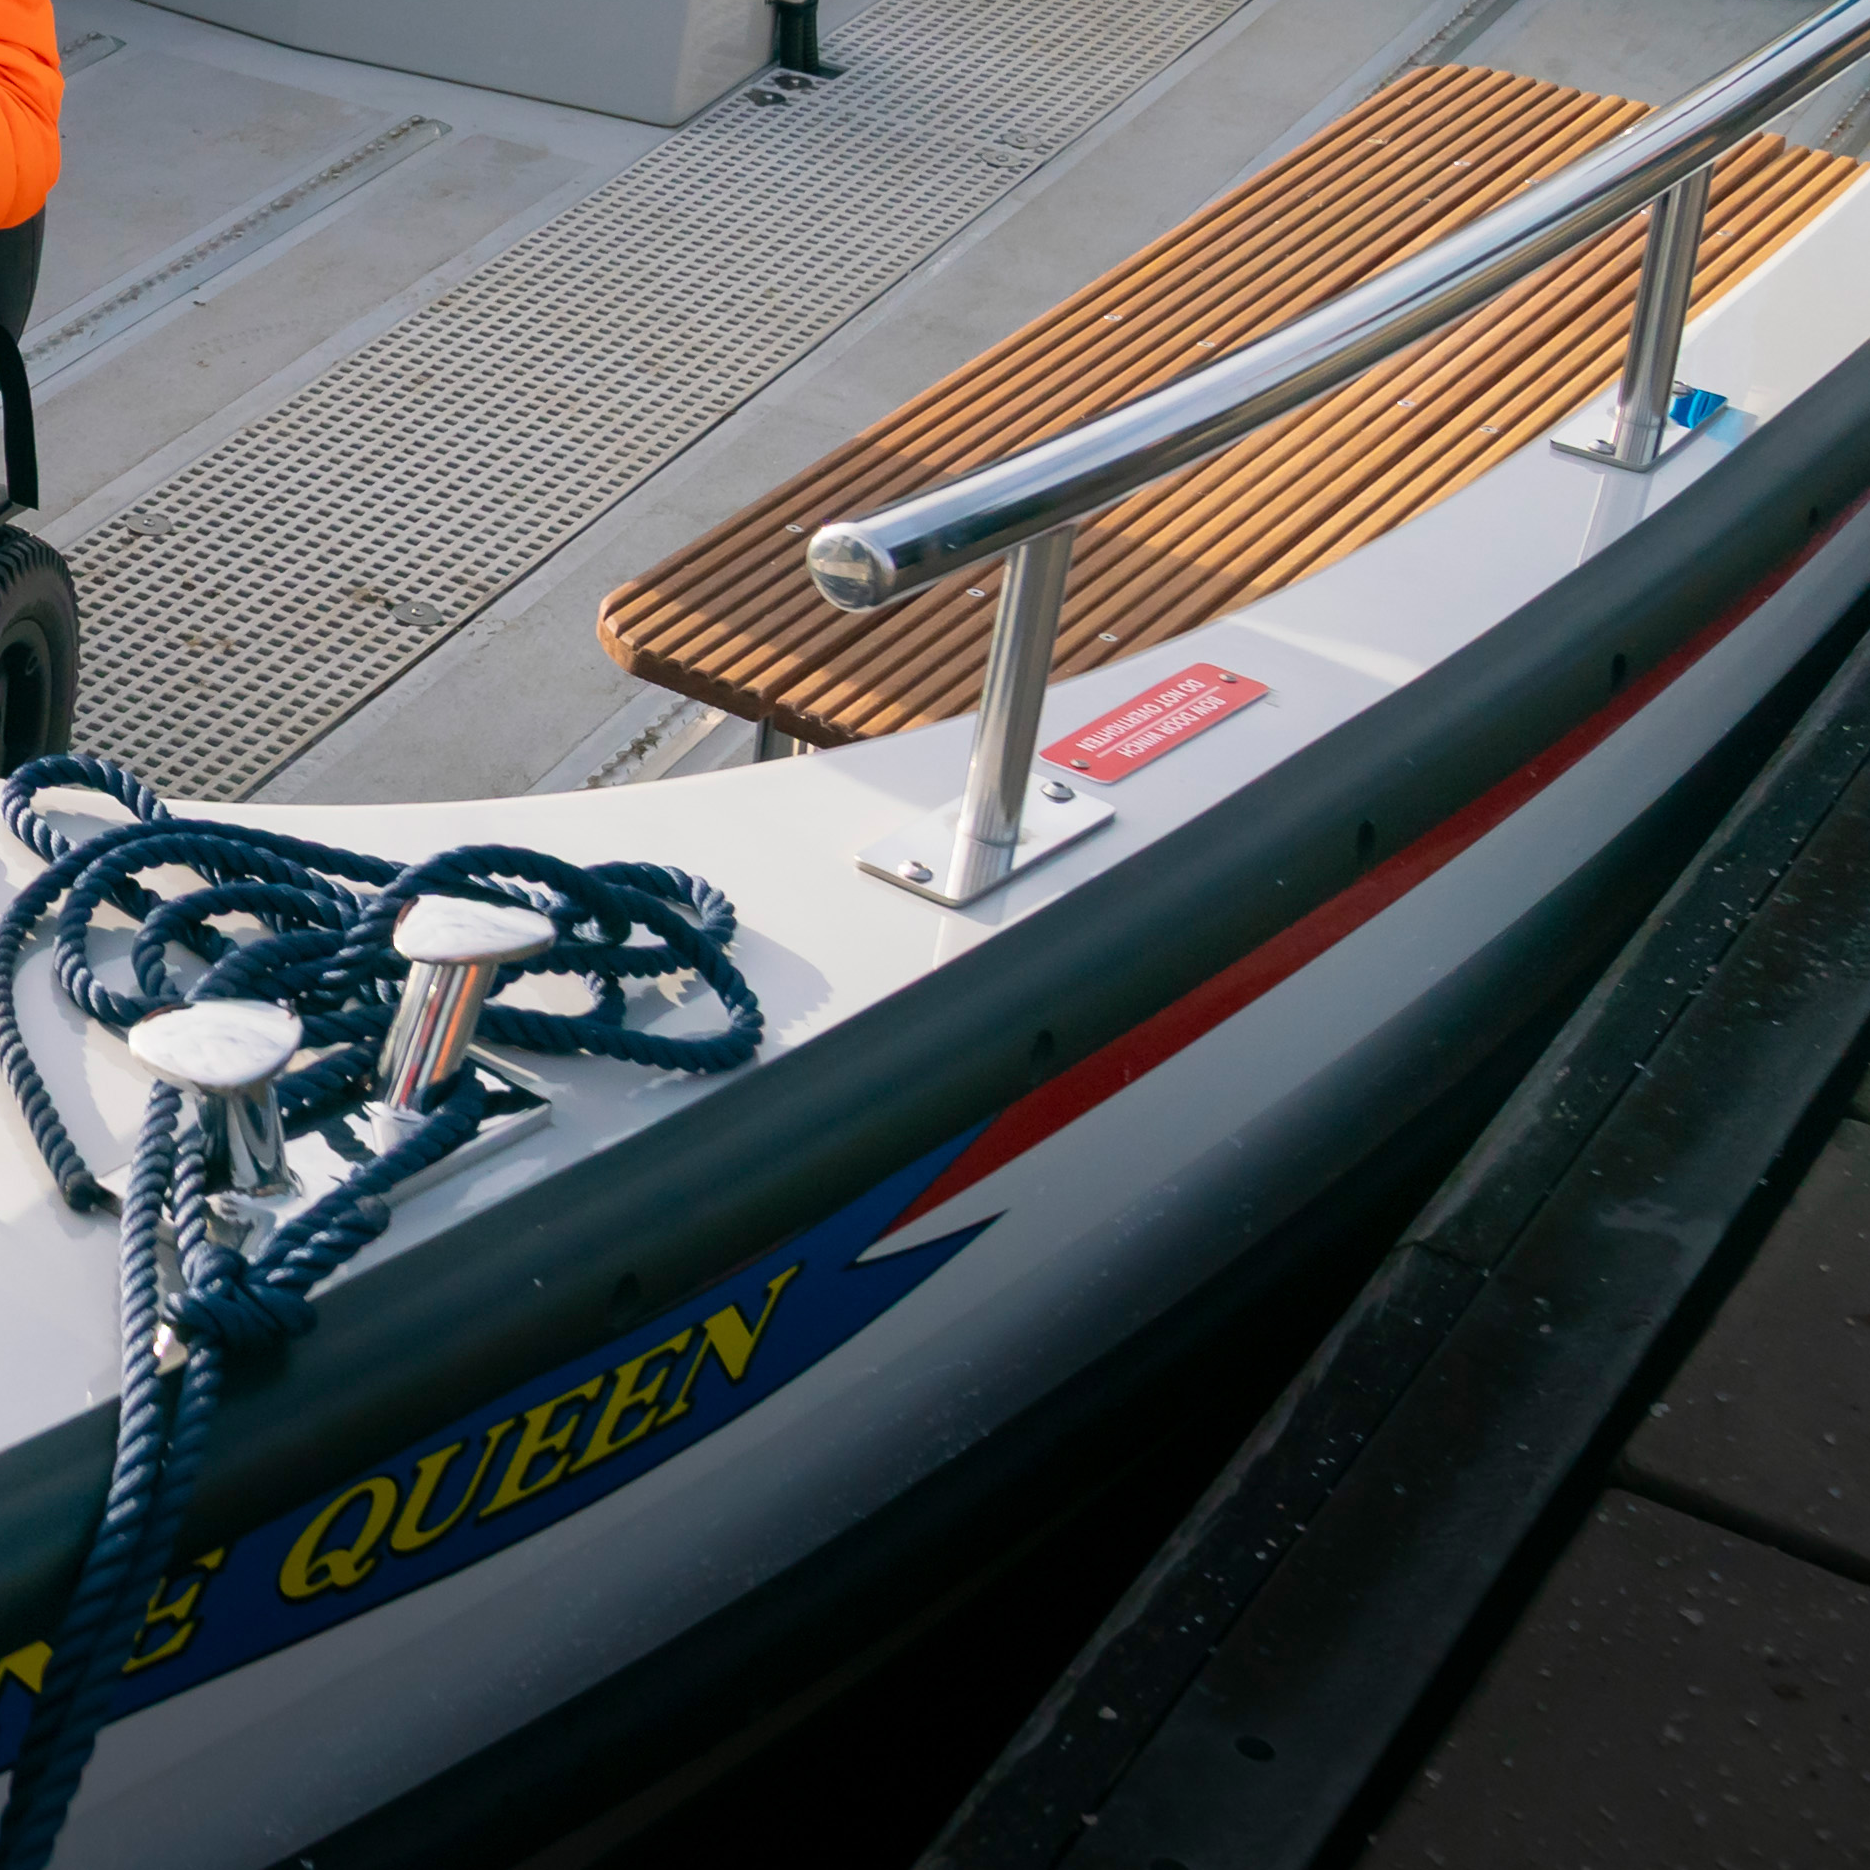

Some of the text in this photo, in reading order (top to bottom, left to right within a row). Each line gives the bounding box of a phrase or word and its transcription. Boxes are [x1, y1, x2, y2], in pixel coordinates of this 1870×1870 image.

[1075, 678, 1206, 752] DO NOT OVERTIGHTEN
[1116, 695, 1227, 758] BOW DOOR WINCH
[274, 1263, 802, 1602] QUEEN
